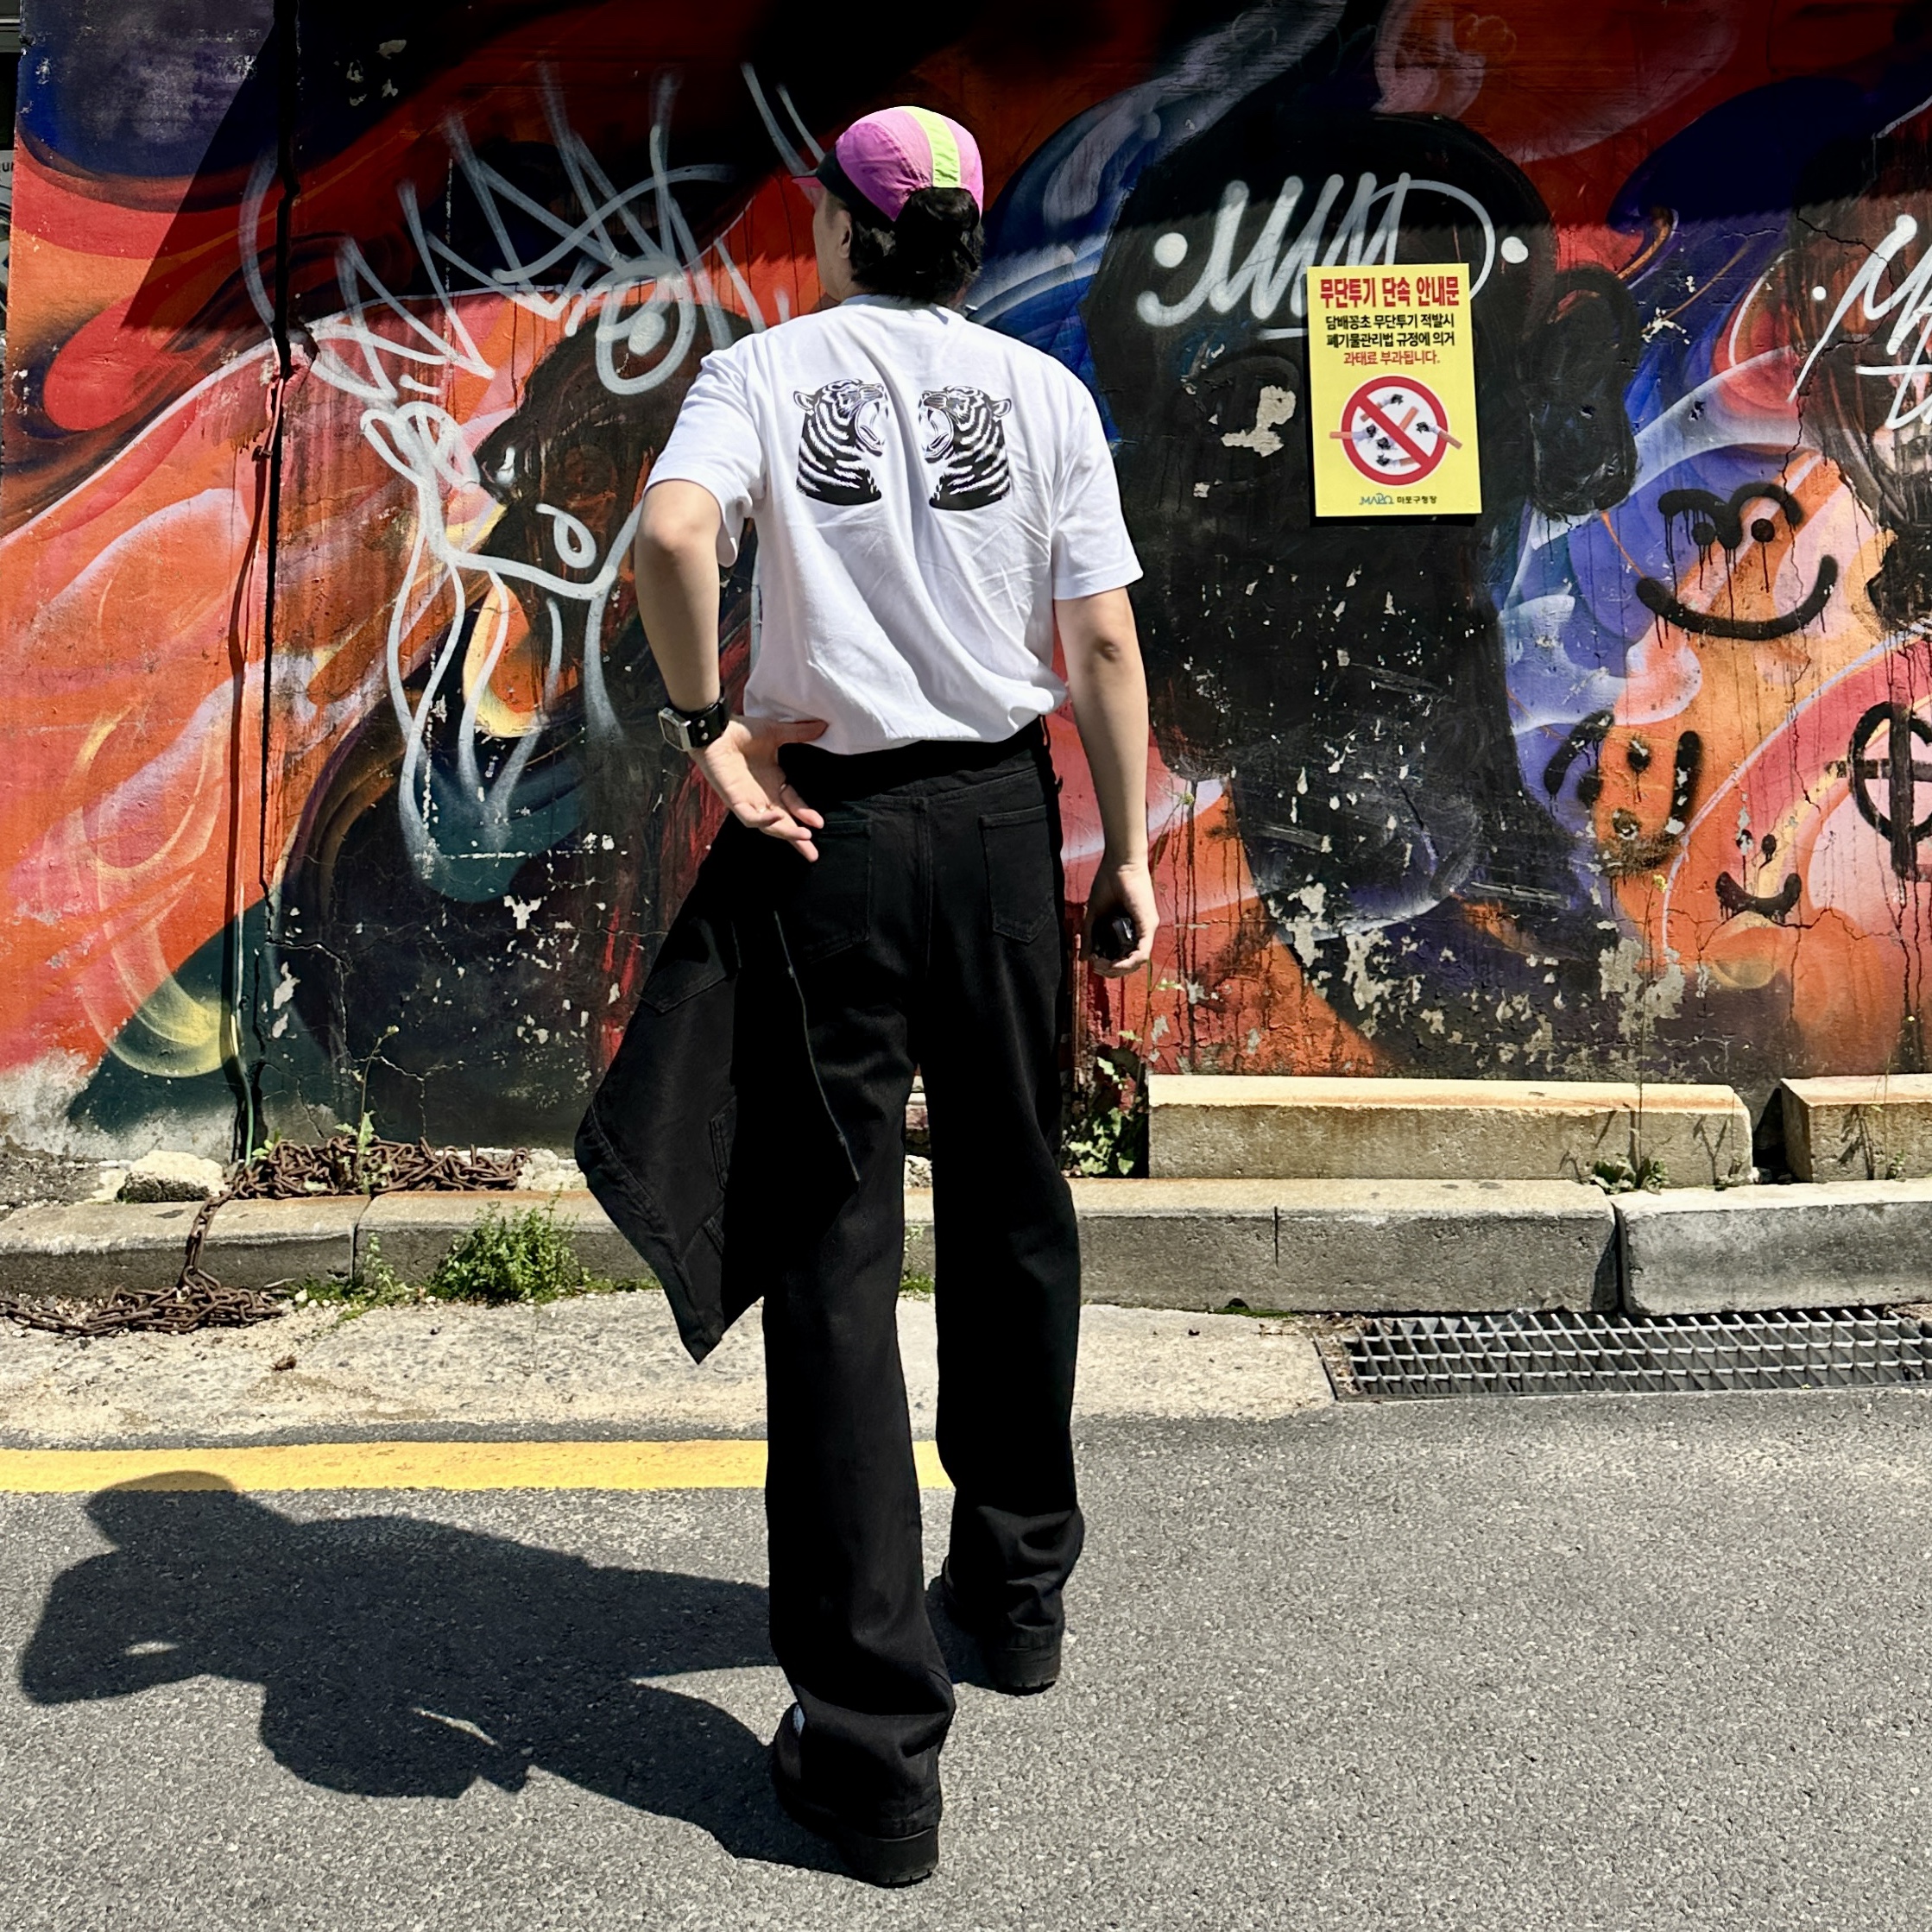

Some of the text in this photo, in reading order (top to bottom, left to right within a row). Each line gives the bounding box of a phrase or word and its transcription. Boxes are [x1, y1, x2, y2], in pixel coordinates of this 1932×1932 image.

[1320, 275, 1460, 308] 무단투기 단속 안내문
[1326, 313, 1455, 331] 담배꽁초 무단투기 적발시
[1327, 331, 1455, 349] 폐기물관리법 규정에 의거
[1343, 350, 1441, 366] 과태료 부과됩니다.
